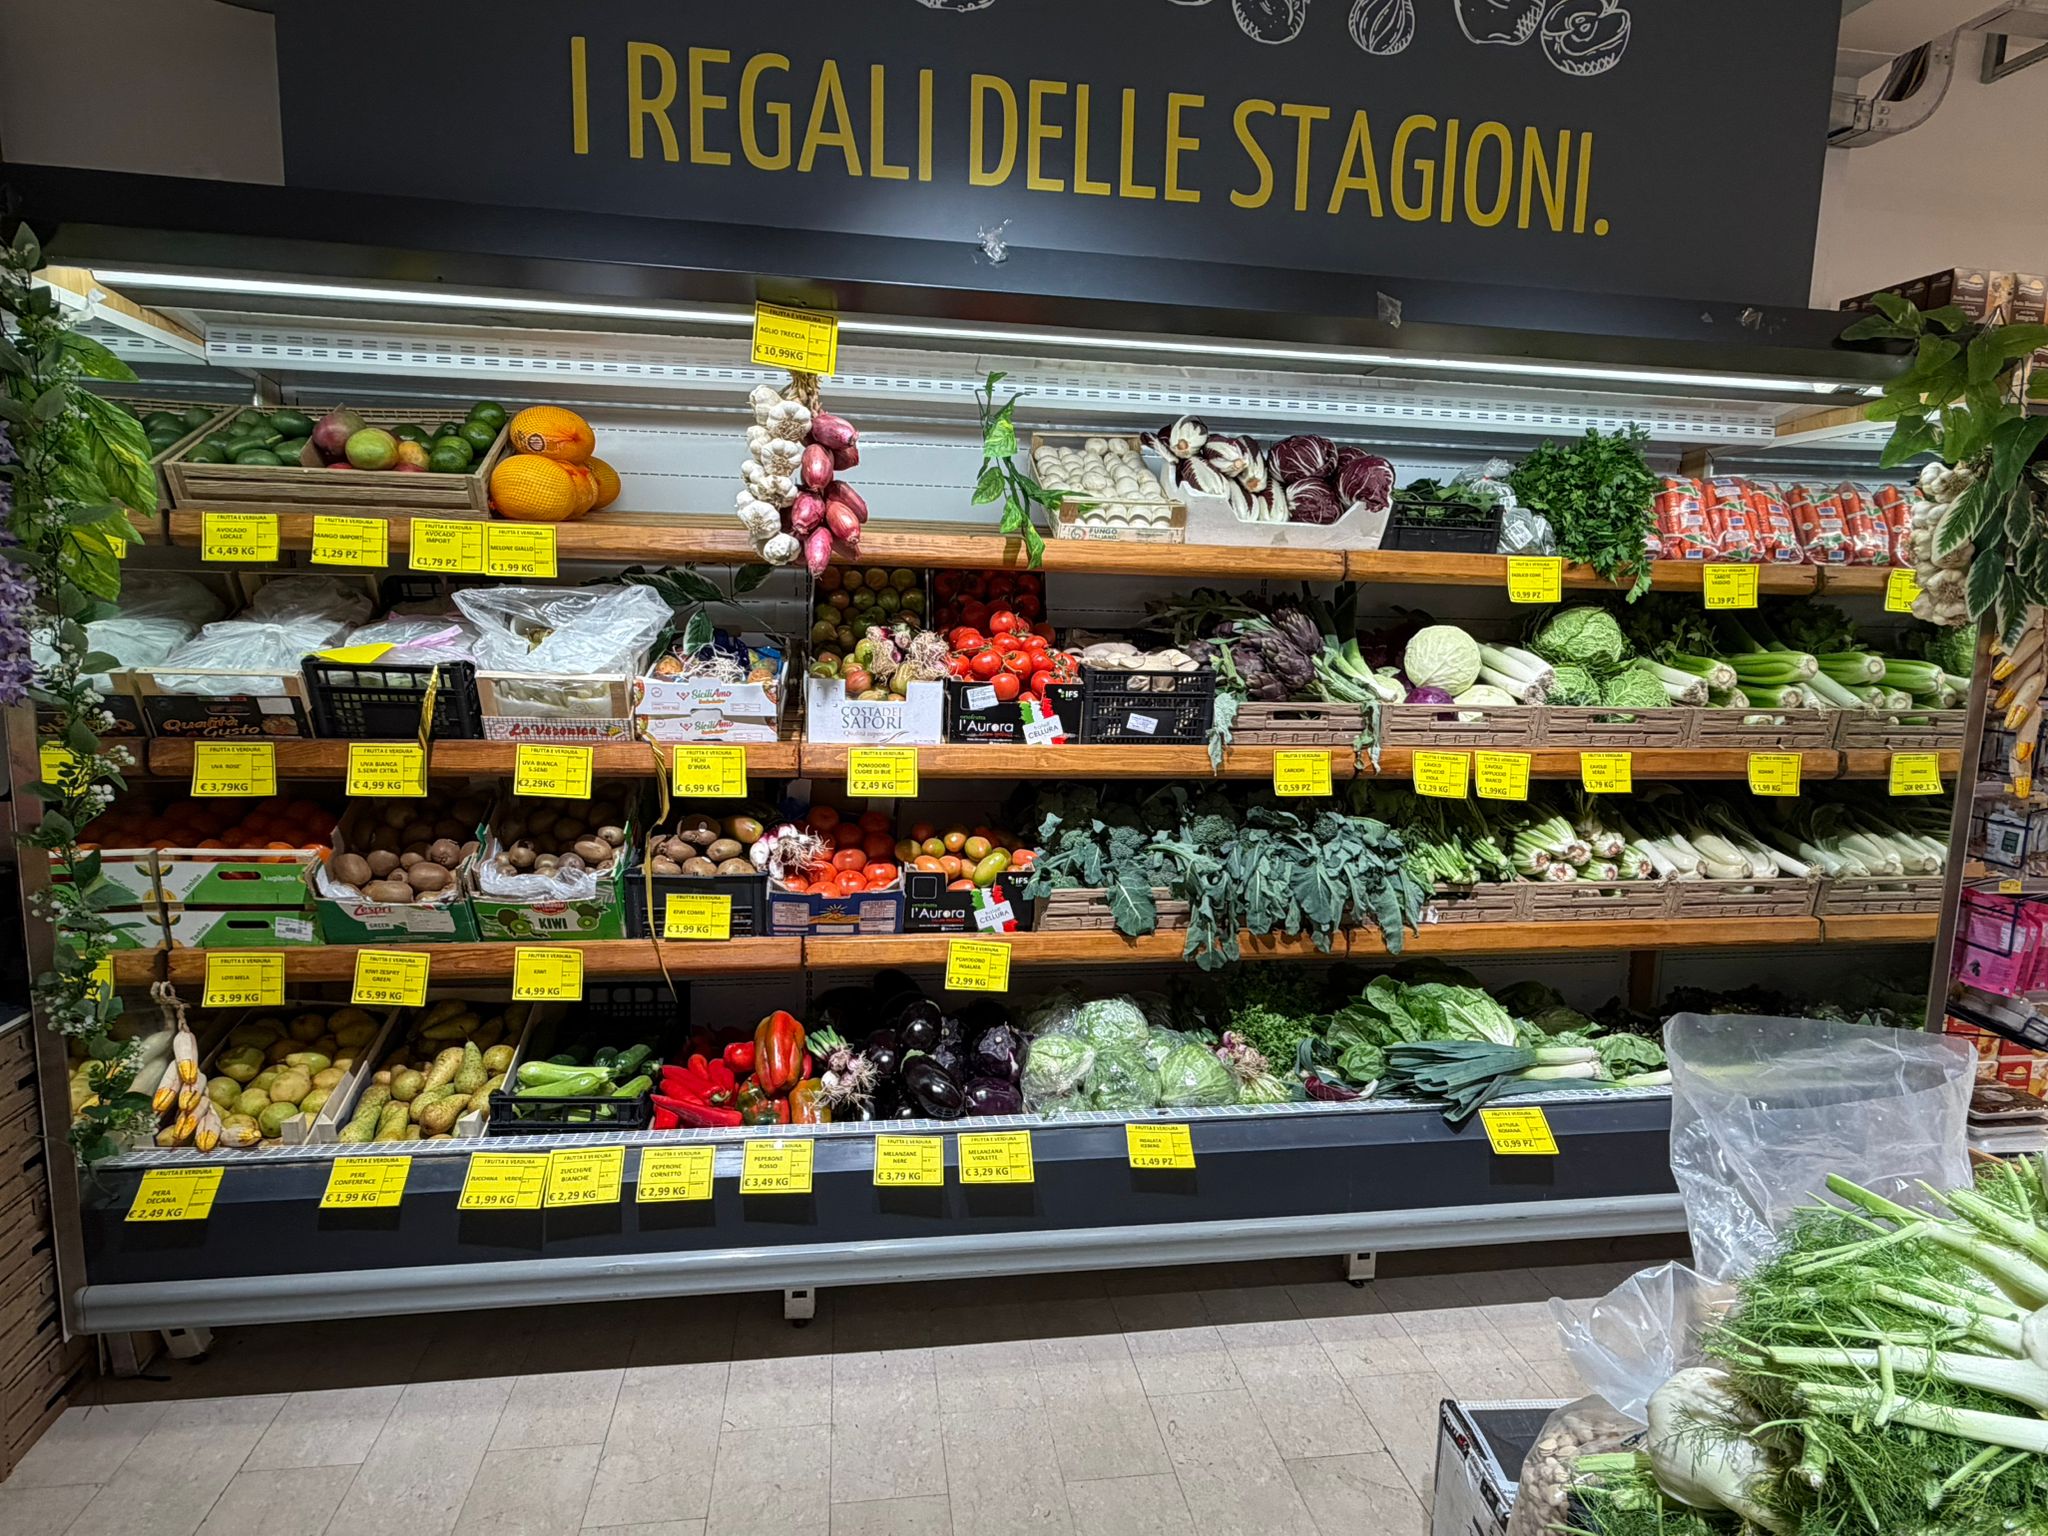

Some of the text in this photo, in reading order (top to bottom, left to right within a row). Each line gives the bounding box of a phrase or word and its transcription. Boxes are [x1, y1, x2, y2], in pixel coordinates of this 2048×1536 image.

[571, 35, 1610, 237] I REGALI DELLE STAGIONI.
[760, 327, 805, 340] AGLIO TRECCIA
[756, 344, 804, 361] € 10,99KG
[217, 547, 238, 555] 4,49
[241, 547, 255, 555] KG
[322, 549, 357, 559] 1,29 PZ
[417, 558, 457, 567] €1,79 PZ
[501, 563, 518, 571] 1,99
[522, 564, 533, 572] KG
[841, 706, 901, 717] COSTA DEI
[842, 716, 901, 729] SAPORI
[203, 724, 260, 737] Gusto
[509, 723, 597, 737] La Veronica
[1027, 725, 1059, 738] CELLURA
[200, 783, 249, 792] € 3,79KG
[353, 781, 360, 789] €
[363, 781, 385, 790] 4,99
[685, 784, 704, 793] 6,99
[861, 782, 879, 790] 2,49
[1284, 784, 1300, 792] 0,59
[1423, 784, 1437, 792] 2,29
[1589, 781, 1602, 789] 1,79
[1759, 784, 1770, 792] 1,99
[980, 909, 1009, 924] CELLURA
[538, 918, 568, 929] KIWI
[675, 925, 694, 934] 1,99
[697, 925, 709, 933] KG
[956, 977, 973, 987] 2,99
[976, 978, 986, 986] KG
[367, 991, 386, 1000] 5,99
[389, 992, 402, 1000] KG
[526, 988, 545, 996] 4,99
[220, 994, 240, 1003] 3,99
[244, 994, 259, 1002] KG
[1504, 1139, 1534, 1149] 0,99 PZ
[1141, 1158, 1160, 1166] 1,49
[560, 1166, 593, 1175] ZUCCHINE
[974, 1168, 992, 1177] 3,29
[886, 1172, 906, 1181] 3,79
[908, 1172, 921, 1180] KG
[334, 1178, 377, 1186] CONFERENCE
[753, 1178, 773, 1188] 3,49
[776, 1177, 789, 1186] KG
[549, 1190, 597, 1201] € 2,29 KG
[640, 1187, 686, 1197] € 2,99 KG
[326, 1193, 377, 1203] € 1,99 KG
[465, 1195, 515, 1205] € 1,99 KG
[129, 1208, 183, 1220] € 2,49 KG
